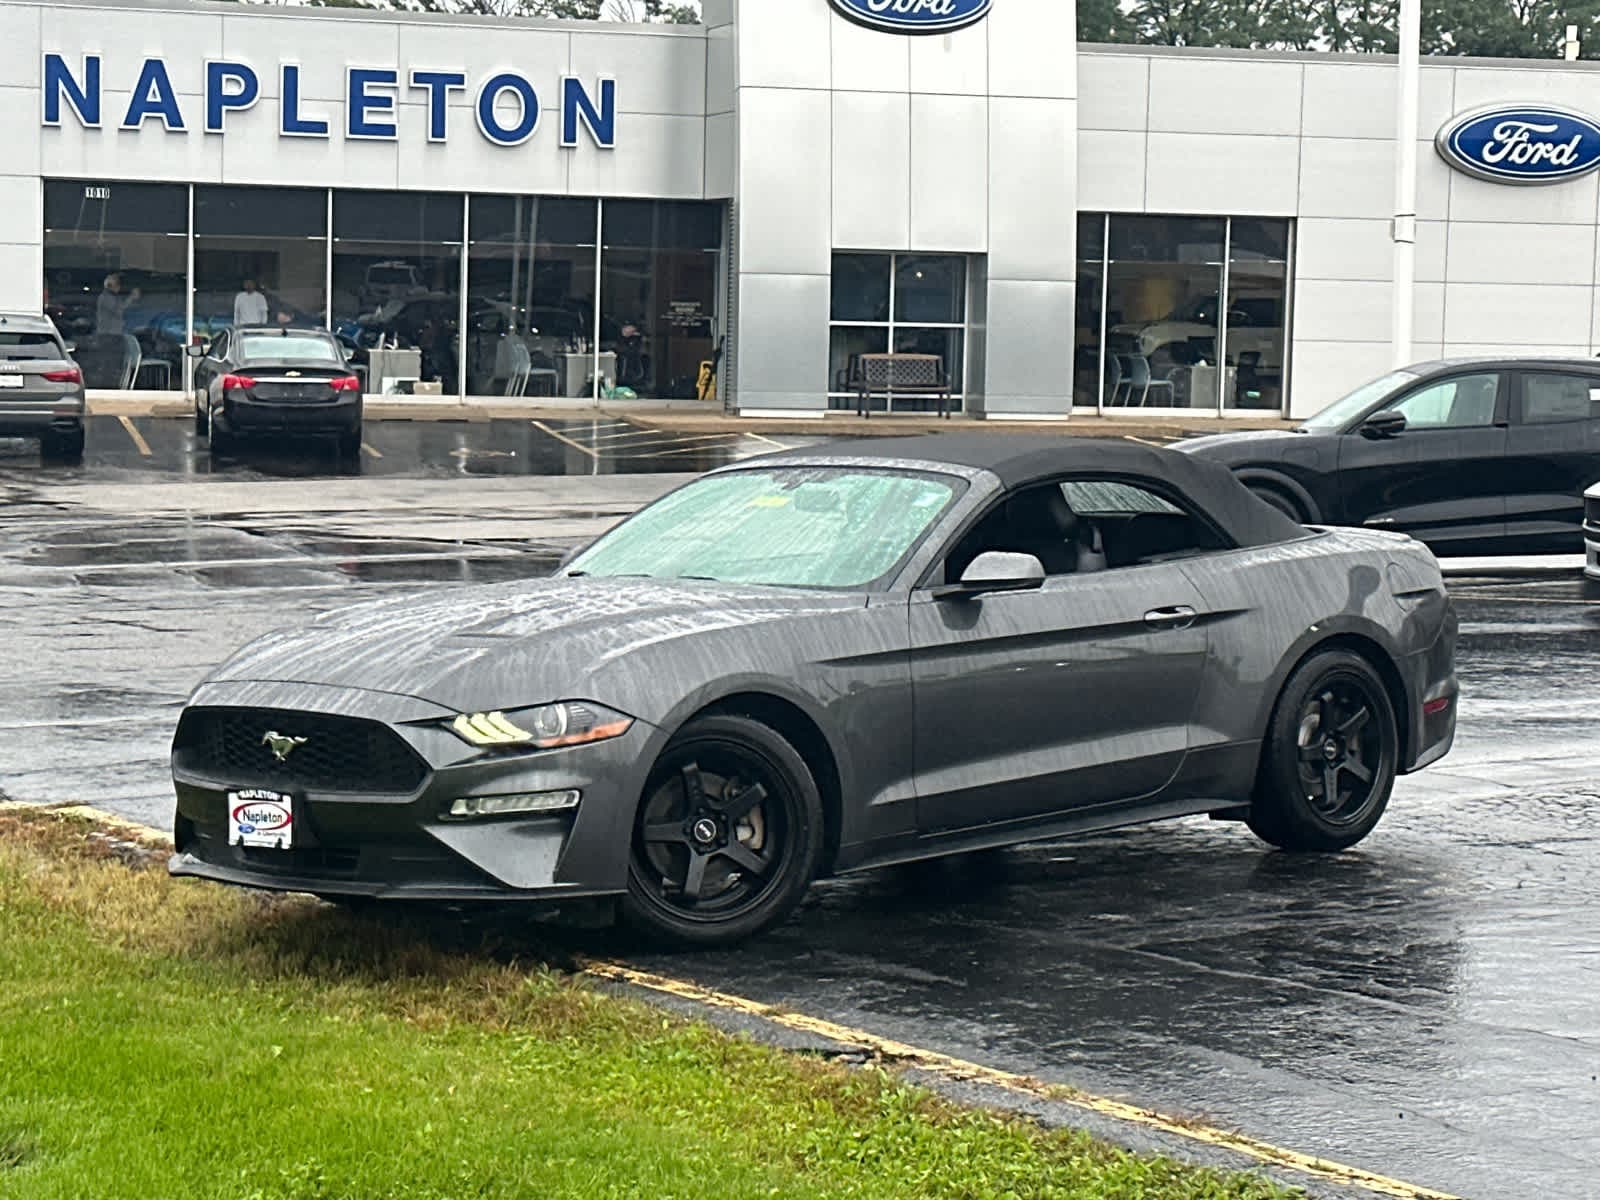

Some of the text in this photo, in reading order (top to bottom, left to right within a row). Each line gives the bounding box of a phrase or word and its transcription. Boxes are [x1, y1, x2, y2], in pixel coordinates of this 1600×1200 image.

[867, 0, 956, 15] ord
[42, 52, 616, 148] NAPLETON
[1482, 121, 1582, 166] Ford
[243, 809, 282, 824] Napleton
